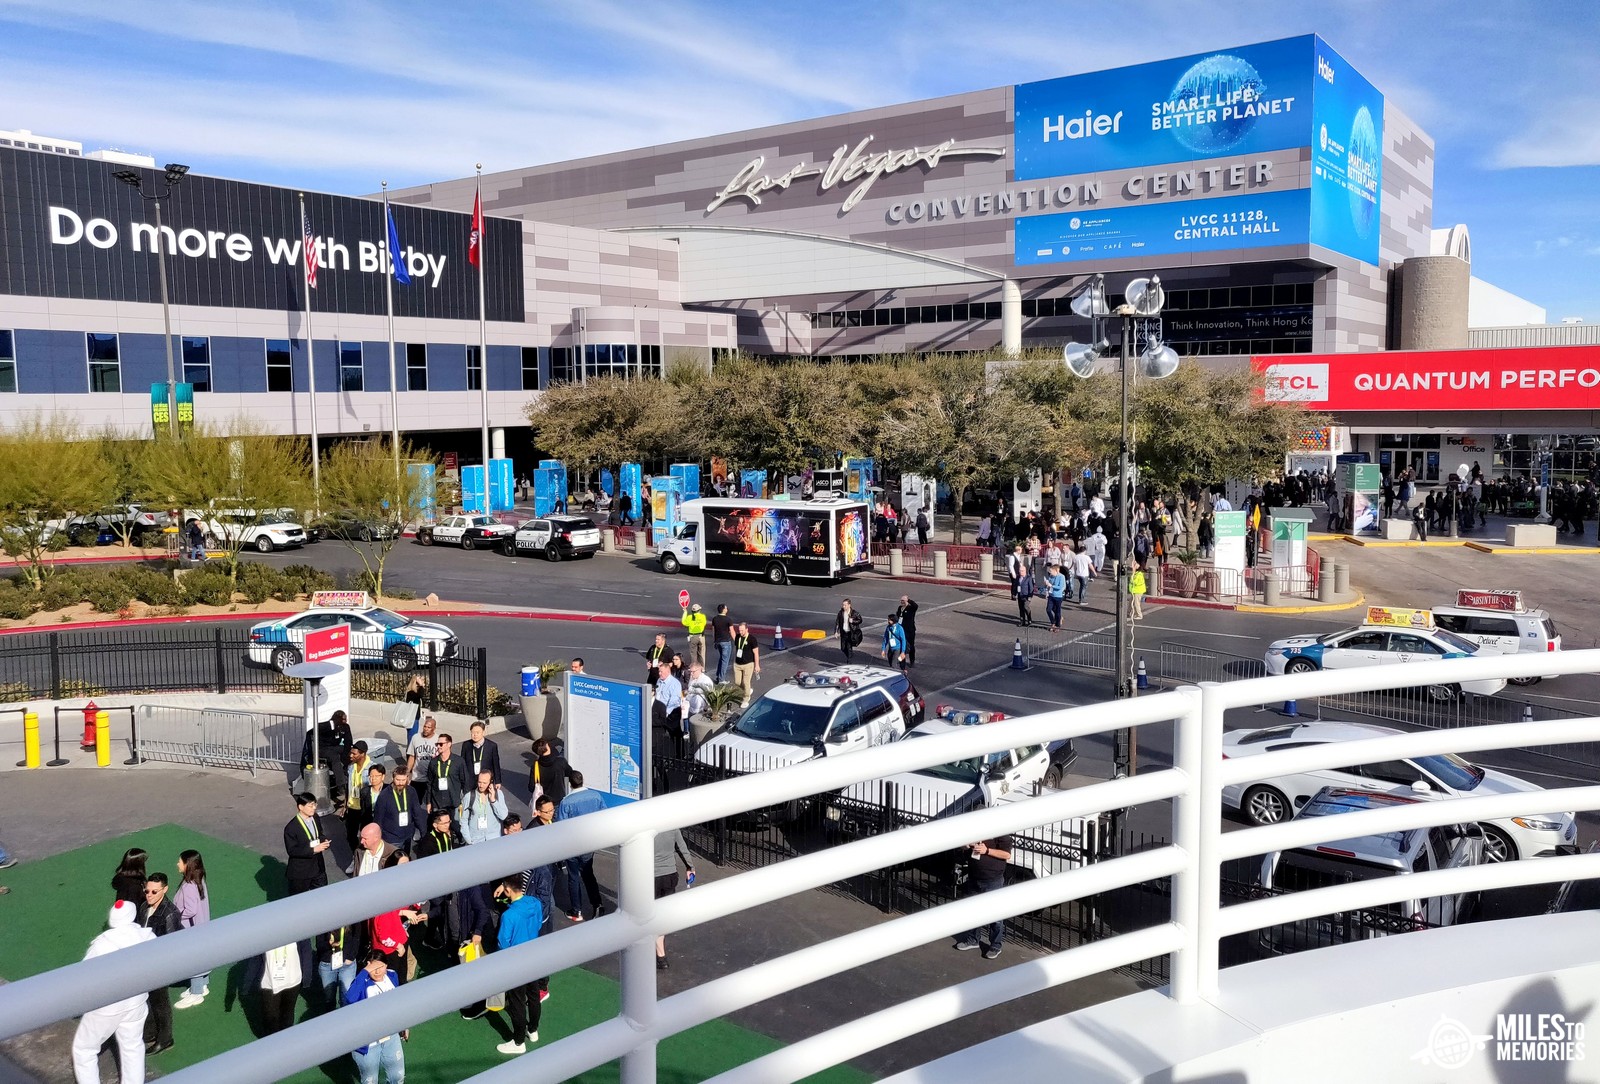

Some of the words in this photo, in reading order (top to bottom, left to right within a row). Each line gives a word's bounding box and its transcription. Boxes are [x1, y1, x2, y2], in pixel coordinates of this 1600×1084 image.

[1318, 55, 1335, 84] Haier
[1151, 95, 1211, 116] SMART
[1215, 87, 1260, 107] LIFE,
[1151, 113, 1217, 131] BETTER
[1222, 97, 1295, 121] PLANET
[1043, 109, 1123, 143] Haier
[706, 156, 823, 212] Las
[821, 134, 1005, 212] Vegas
[888, 179, 1102, 222] CONVENTION
[1127, 160, 1274, 196] CENTER
[1181, 214, 1218, 227] LVCC
[1223, 210, 1268, 224] 11128,
[49, 206, 118, 249] Do
[131, 222, 253, 262] more
[263, 235, 350, 270] wth
[1174, 228, 1238, 241] CENTRAL
[1242, 222, 1280, 235] HALL
[1171, 321, 1193, 330] Think
[1196, 320, 1243, 329] Innovation,
[1246, 318, 1270, 327] Think
[1273, 318, 1298, 327] Hong
[1277, 376, 1318, 390] TCL
[1354, 371, 1490, 391] QUANTUM
[1500, 368, 1600, 389] PERFO
[154, 411, 169, 422] CES
[178, 410, 193, 421] CES
[1446, 437, 1476, 445] FedEx
[1356, 466, 1364, 476] 2
[1472, 596, 1499, 605] ABSINTHE
[1477, 636, 1497, 645] Deluxe
[318, 647, 345, 657] Restrictions
